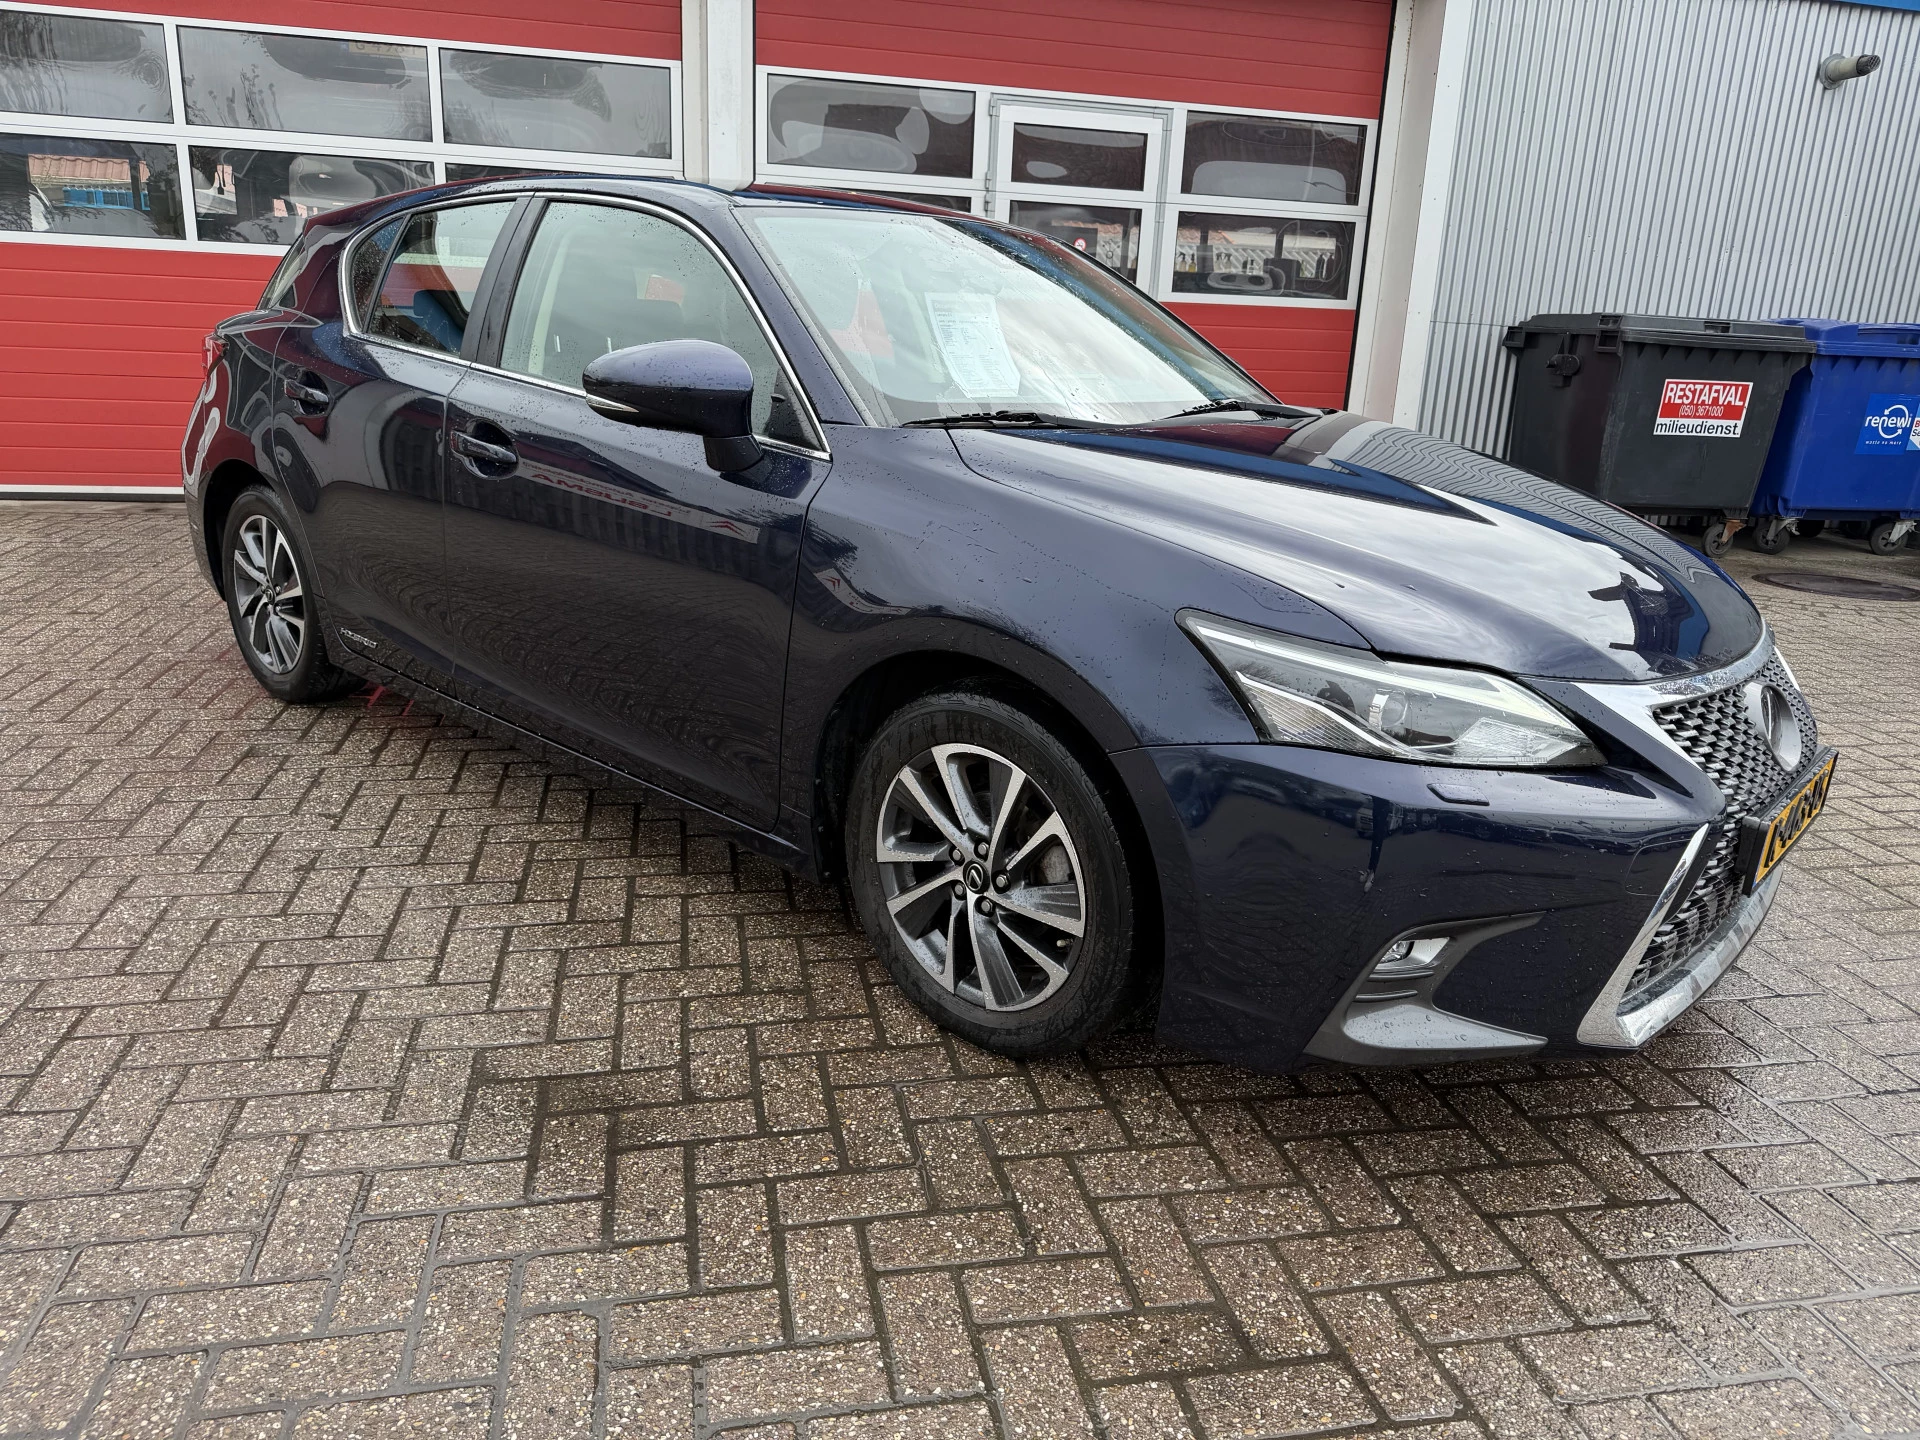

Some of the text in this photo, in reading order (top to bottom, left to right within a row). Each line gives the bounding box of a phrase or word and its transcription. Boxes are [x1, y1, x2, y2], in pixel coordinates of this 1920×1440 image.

[1665, 383, 1744, 406] RESTAFVAL
[1679, 404, 1724, 418] (050) 3671000
[1864, 412, 1913, 430] renewi
